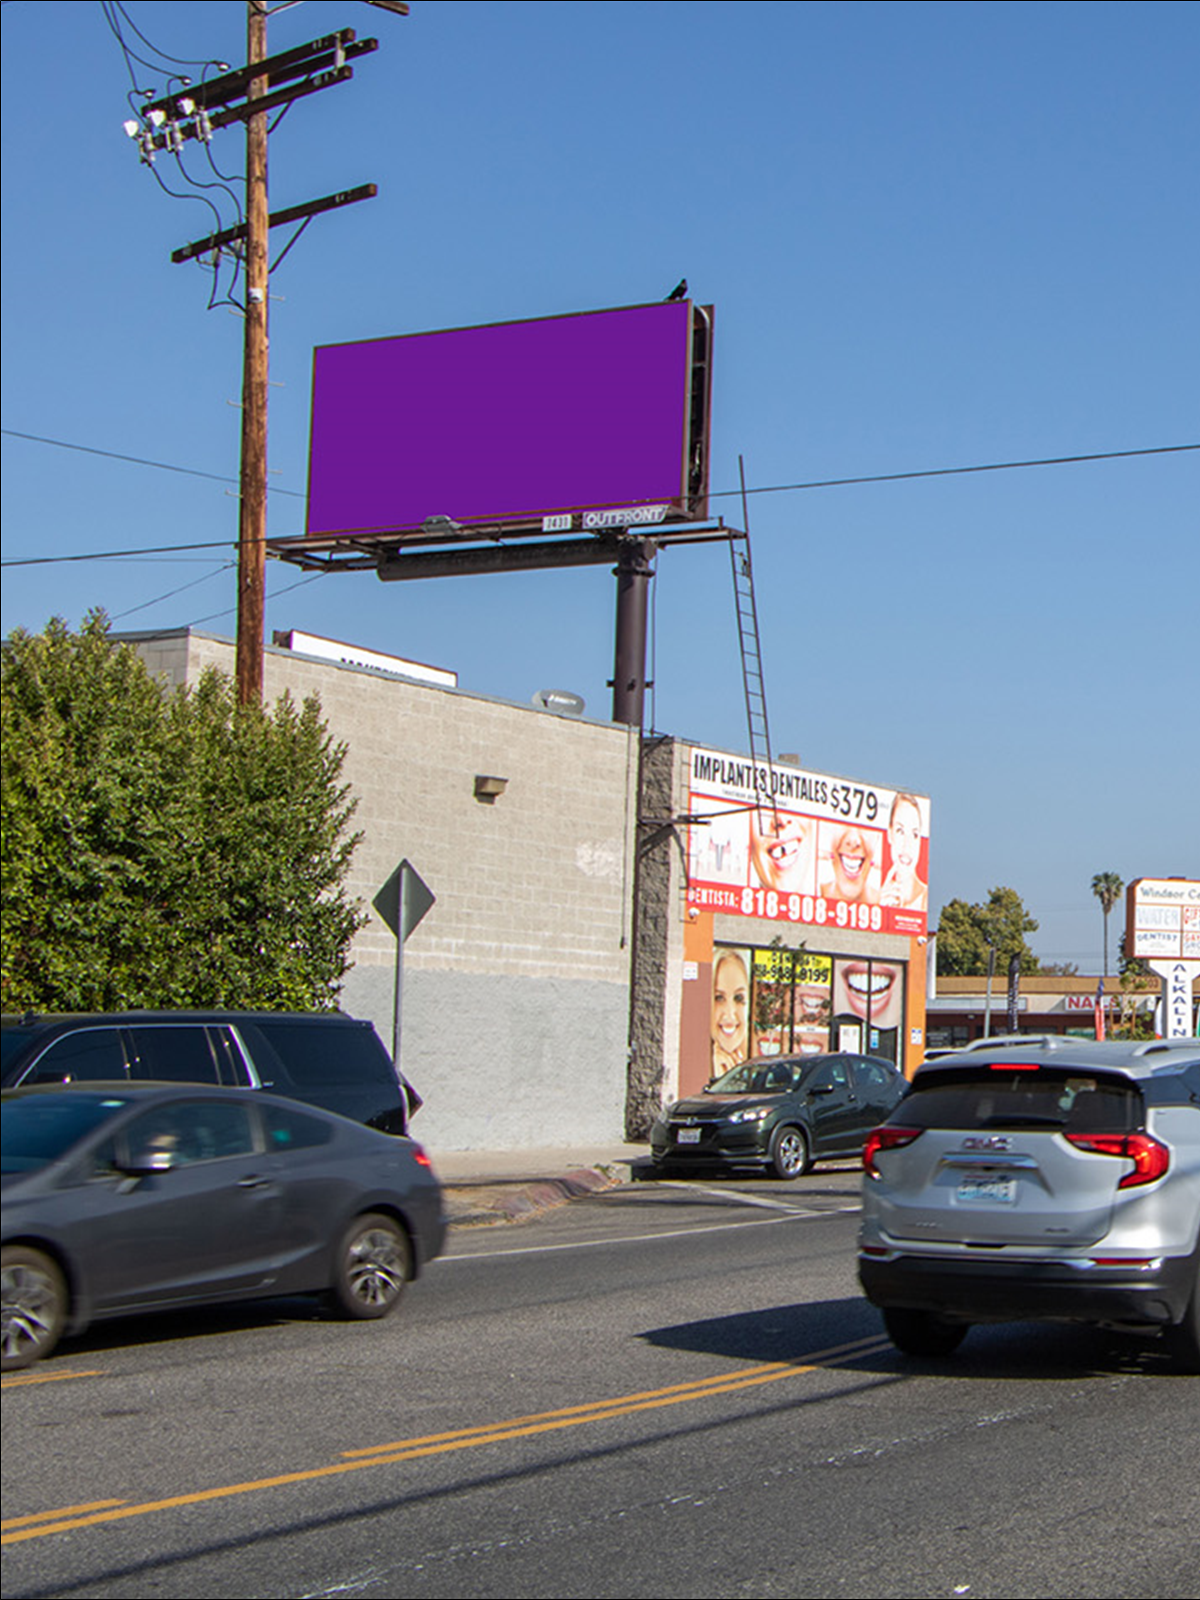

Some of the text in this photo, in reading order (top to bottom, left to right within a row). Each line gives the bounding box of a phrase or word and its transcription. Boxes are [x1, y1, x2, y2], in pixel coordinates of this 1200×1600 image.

[586, 507, 664, 526] OUTFRONT
[694, 754, 767, 792] IMPLANTES
[770, 770, 827, 805] DENTALES
[830, 783, 878, 821] $379
[740, 886, 882, 931] 818-908-9199
[1140, 886, 1184, 899] Windsor
[1172, 963, 1187, 1036] ALKALIN
